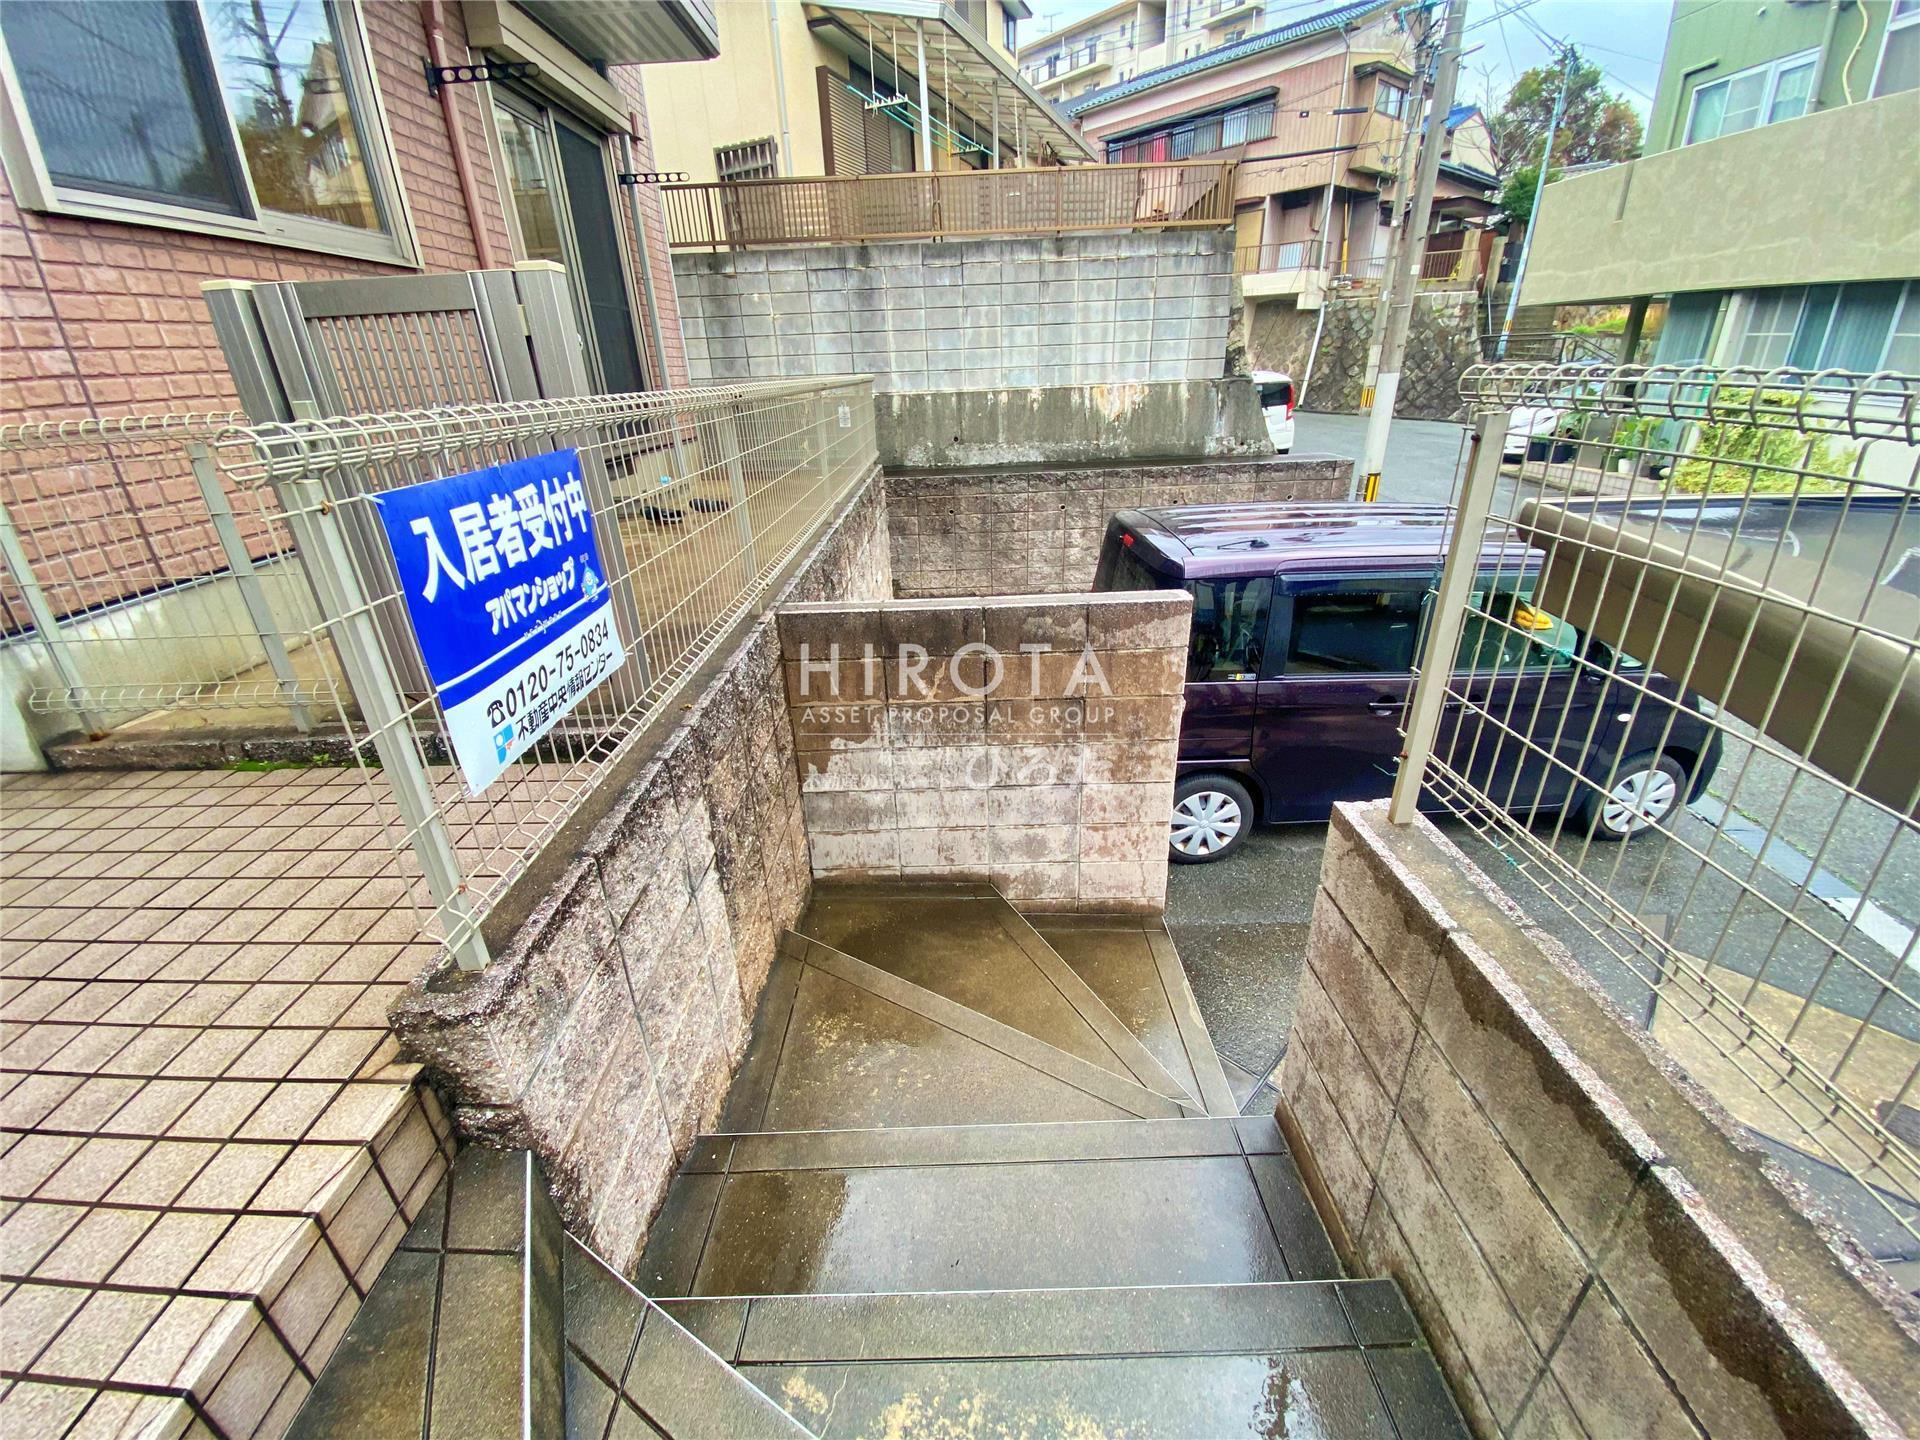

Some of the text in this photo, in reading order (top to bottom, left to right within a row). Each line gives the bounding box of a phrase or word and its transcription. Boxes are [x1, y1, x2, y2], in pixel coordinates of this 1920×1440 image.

[409, 471, 588, 604] 入居者受付中
[485, 555, 575, 636] アパマンショップ
[505, 617, 609, 718] 0120-75-0834
[515, 651, 613, 741] 不動産中央情報センター
